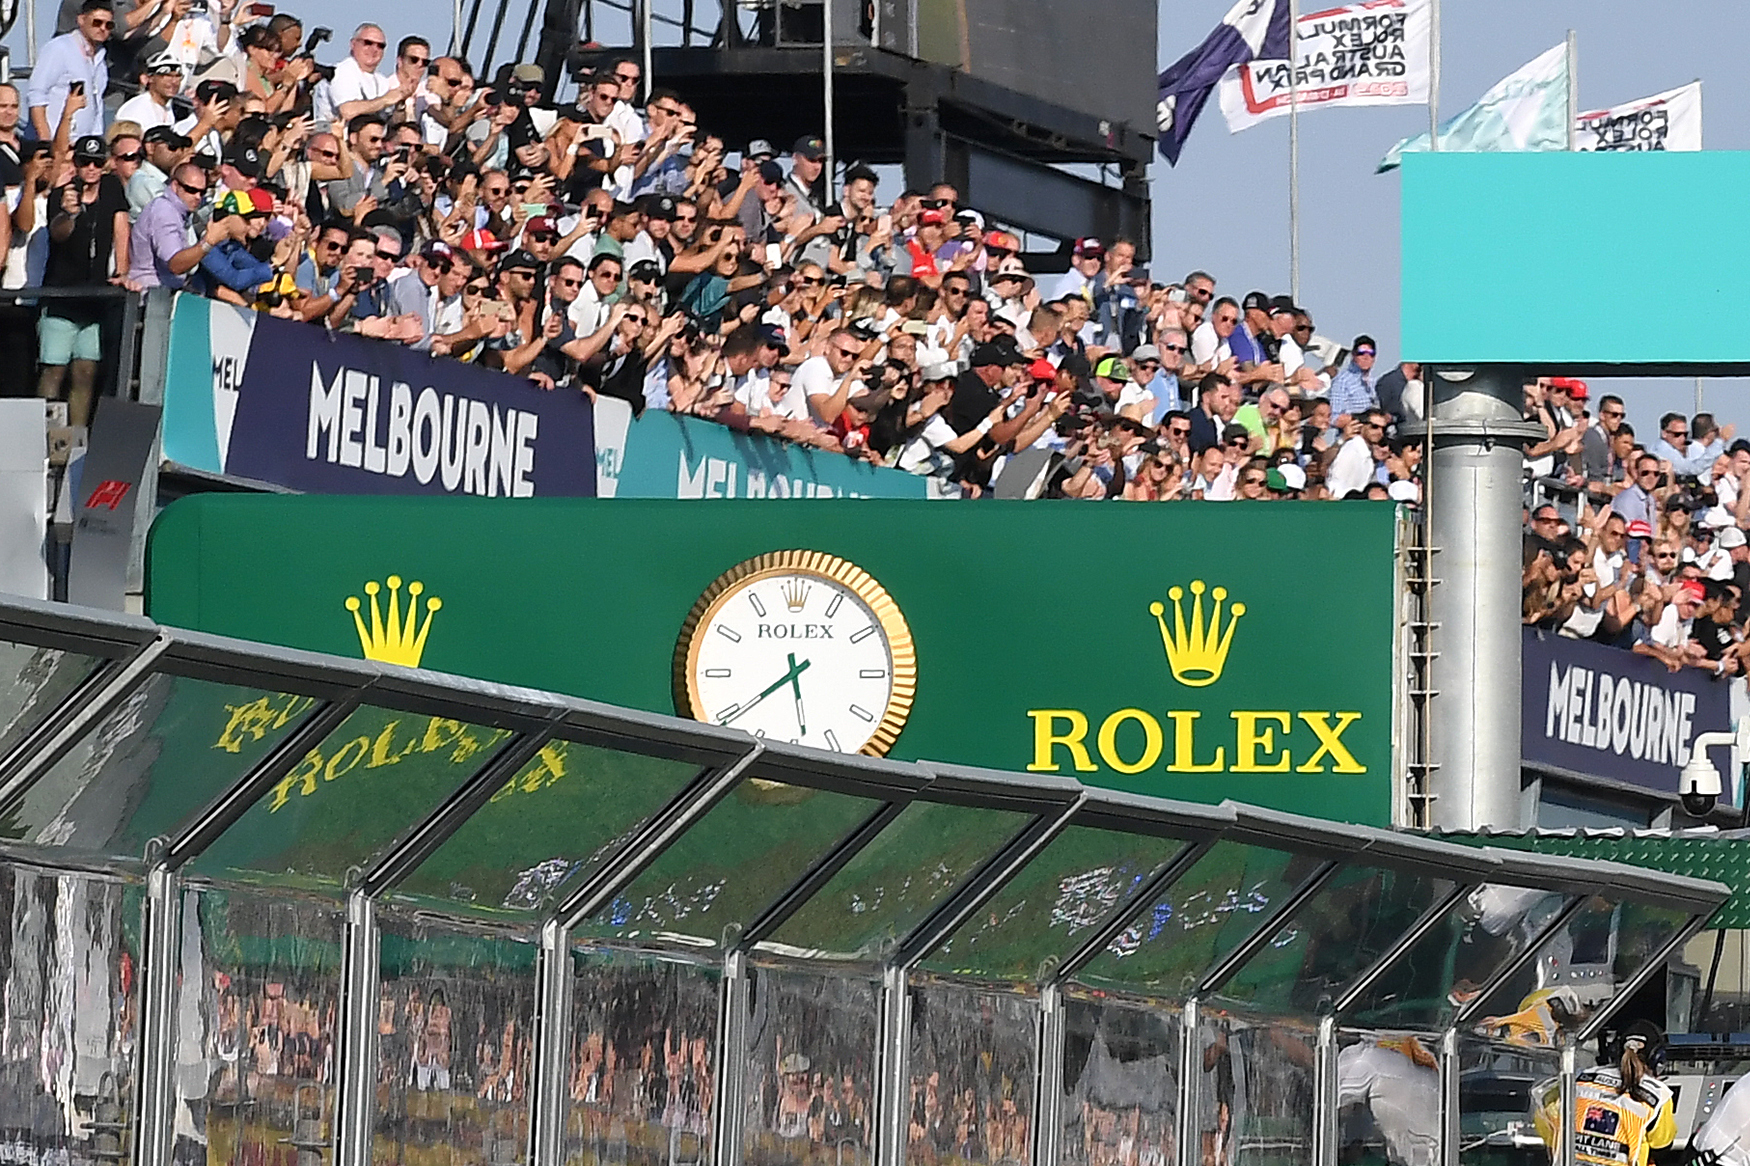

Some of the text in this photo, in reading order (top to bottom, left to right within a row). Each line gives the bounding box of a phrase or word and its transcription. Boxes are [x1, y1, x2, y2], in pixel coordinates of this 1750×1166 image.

[212, 354, 539, 498] MEL MELBOURNE
[757, 623, 834, 640] ROLEX
[1026, 708, 1367, 774] ROLEX
[1546, 660, 1696, 767] MELBOURNE
